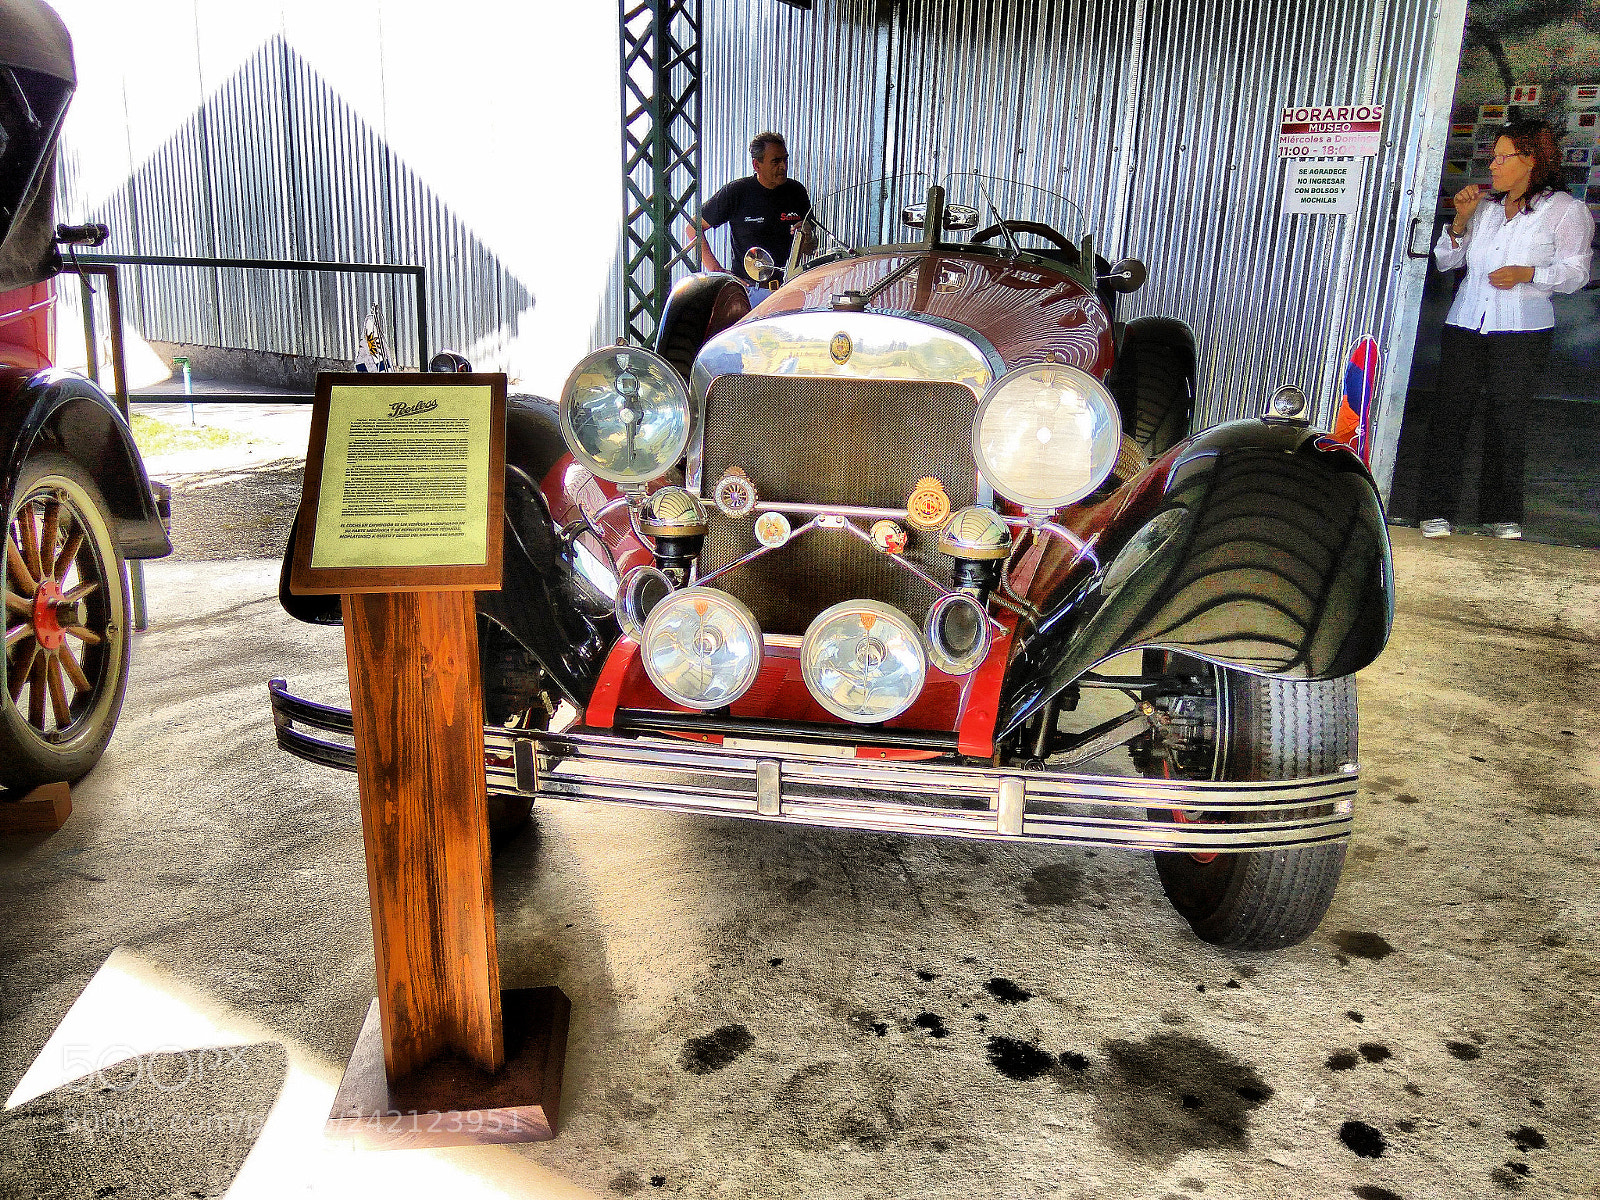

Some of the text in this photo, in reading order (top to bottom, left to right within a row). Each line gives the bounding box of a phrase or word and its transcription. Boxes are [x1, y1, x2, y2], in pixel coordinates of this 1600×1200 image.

[1282, 106, 1383, 122] HORARIOS
[1308, 123, 1352, 133] MUSEO
[1279, 135, 1324, 144] Miércoles
[1279, 146, 1310, 156] 11:00
[1322, 145, 1356, 155] 18:00
[387, 399, 438, 418] Peerless
